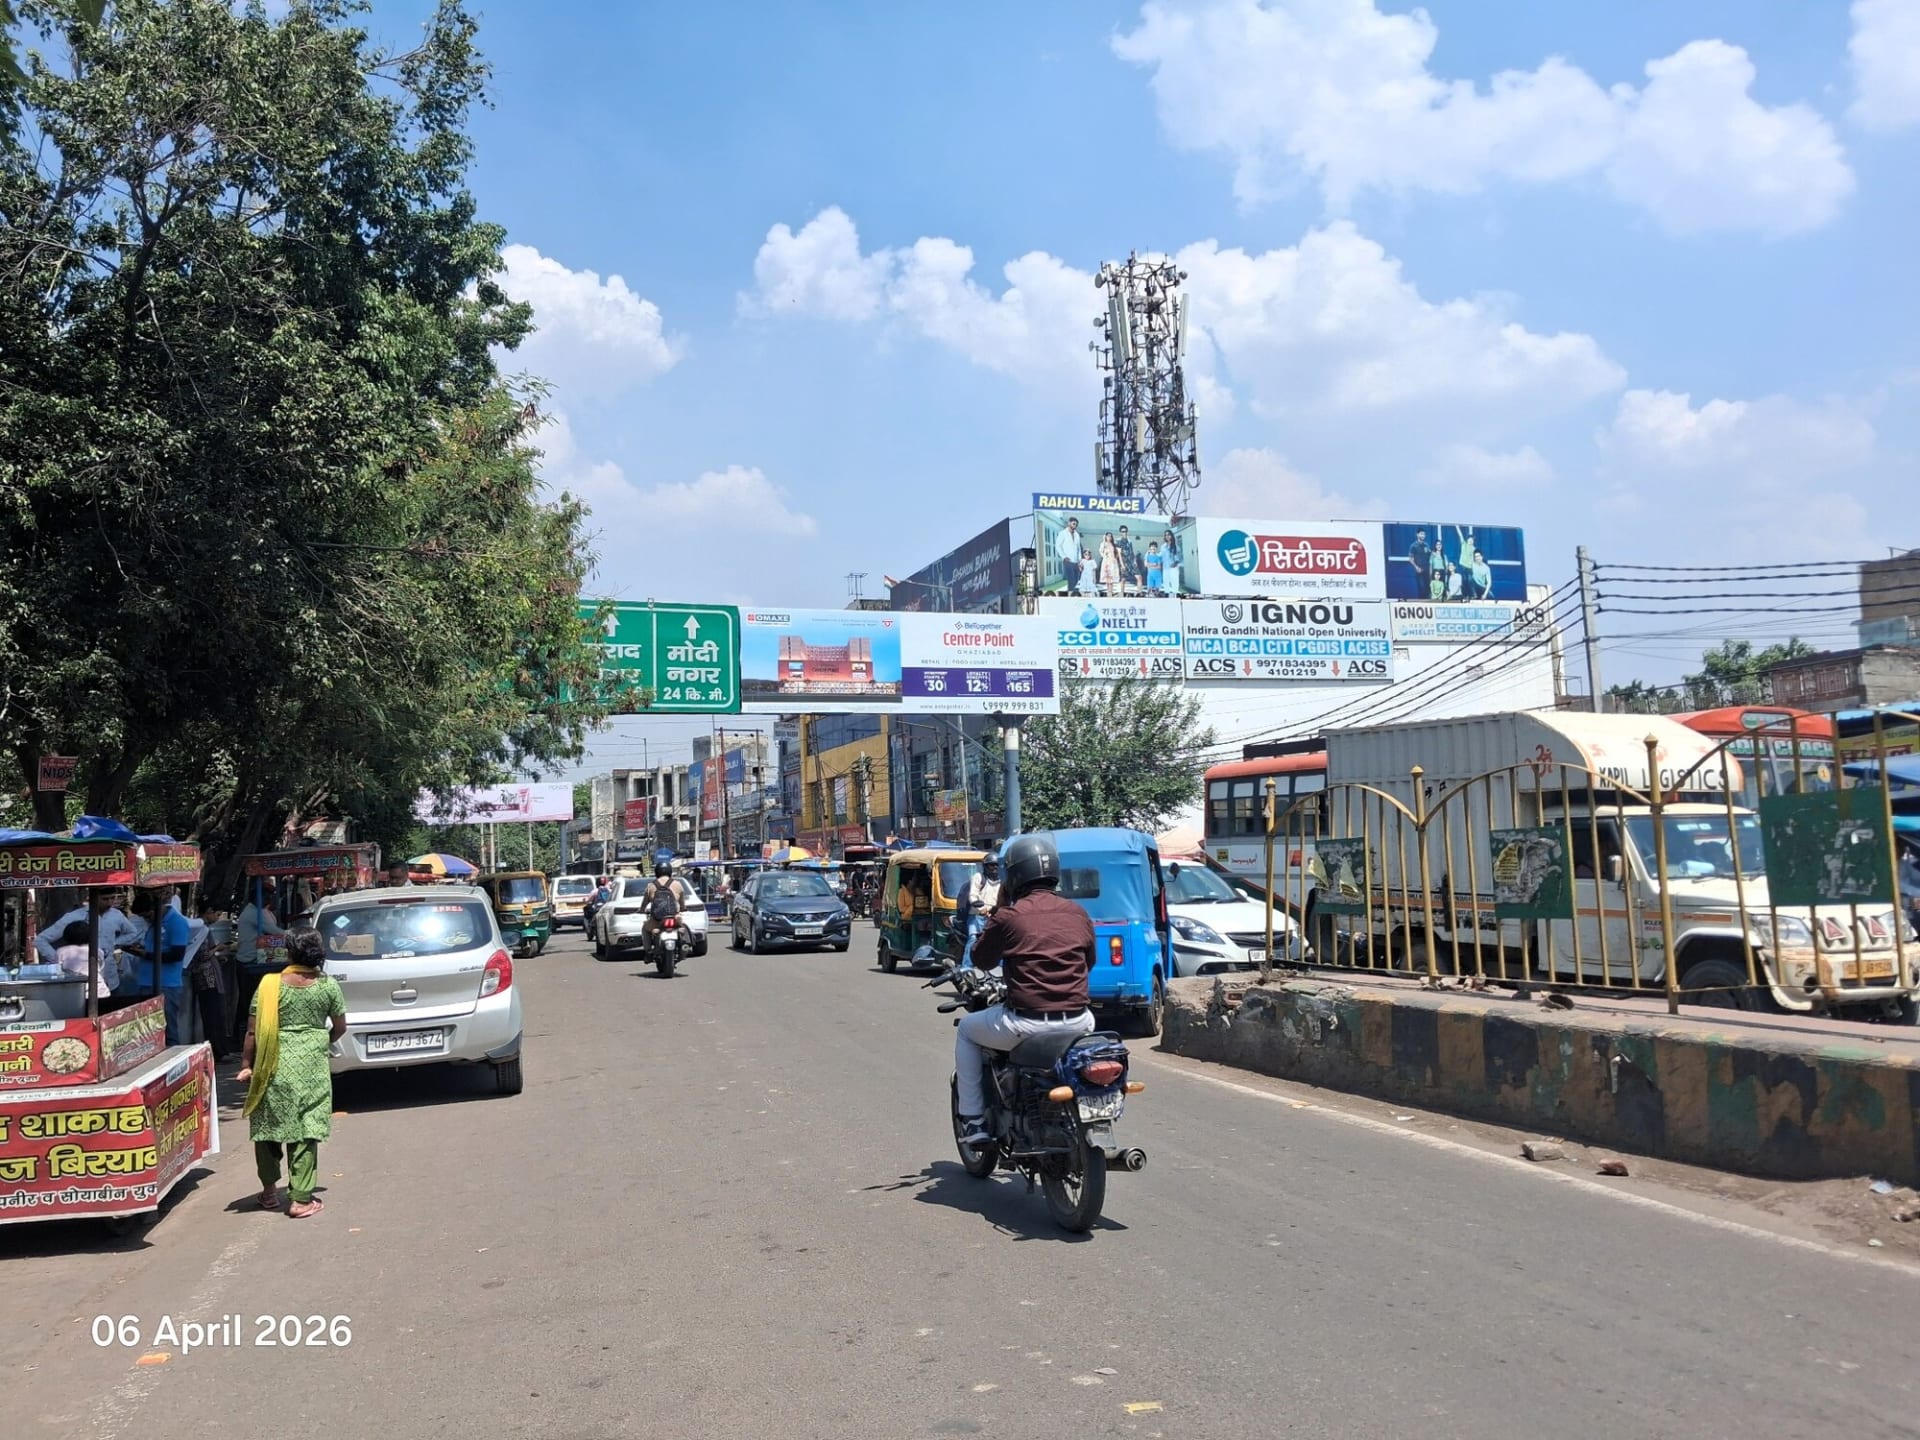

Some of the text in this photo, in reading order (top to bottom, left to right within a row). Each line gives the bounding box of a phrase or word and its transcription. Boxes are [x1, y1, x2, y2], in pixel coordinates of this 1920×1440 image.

[1039, 495, 1140, 511] RAHUL PALACE
[1262, 540, 1359, 570] सिटीकार्ट
[757, 614, 790, 622] OMAXE
[1250, 603, 1353, 625] IGNOU
[1394, 607, 1433, 619] IGNOU
[1102, 618, 1148, 629] NIELIT
[1439, 624, 1464, 632] CCC
[943, 632, 1014, 647] Centre Point
[1105, 632, 1120, 645] O
[1126, 632, 1177, 645] Level
[1187, 626, 1387, 639] Indira Gandhi National Open University
[666, 640, 720, 663] मोदी
[1187, 639, 1388, 655] MCA BCA CIT PGDIS ACISE
[1092, 658, 1136, 667] 9971834395
[1151, 657, 1182, 672] ACS
[1193, 658, 1387, 673] ACS 9971834395 ACS
[666, 666, 721, 684] नगर
[1267, 668, 1317, 677] 4101219
[663, 687, 681, 700] 24
[988, 701, 1044, 711] 9999 999 831
[1642, 767, 1727, 790] LGISTICS
[18, 853, 52, 873] वेज
[56, 849, 127, 873] बिरयानी
[374, 1037, 388, 1049] UP
[415, 1033, 442, 1046] 3674
[59, 1184, 126, 1203] सोयाबीन
